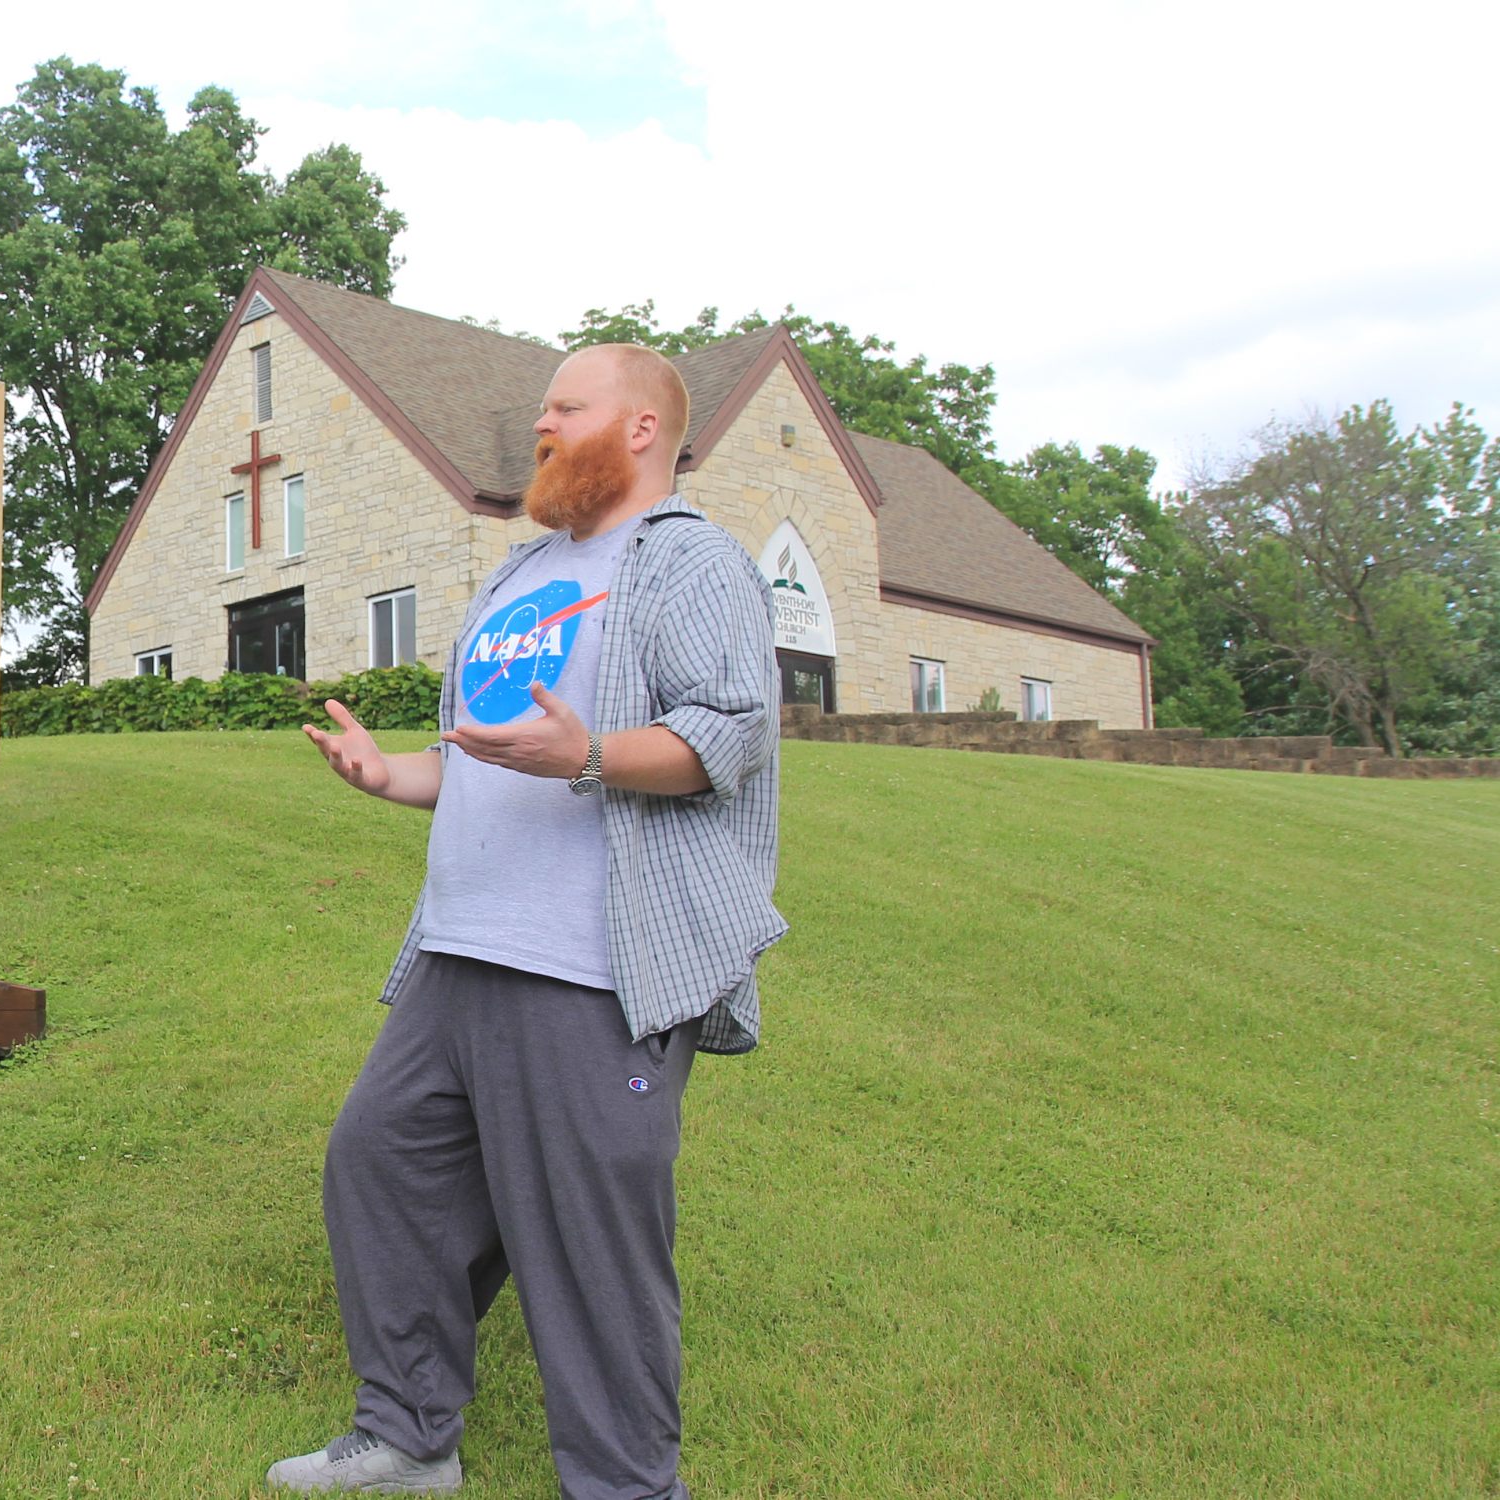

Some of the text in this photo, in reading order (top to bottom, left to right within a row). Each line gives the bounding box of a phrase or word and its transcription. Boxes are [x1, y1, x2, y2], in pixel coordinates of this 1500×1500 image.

[772, 593, 816, 611] VENTH-DAY
[774, 605, 820, 627] VENTIST
[776, 621, 806, 635] CHURCH
[468, 624, 563, 663] NASA
